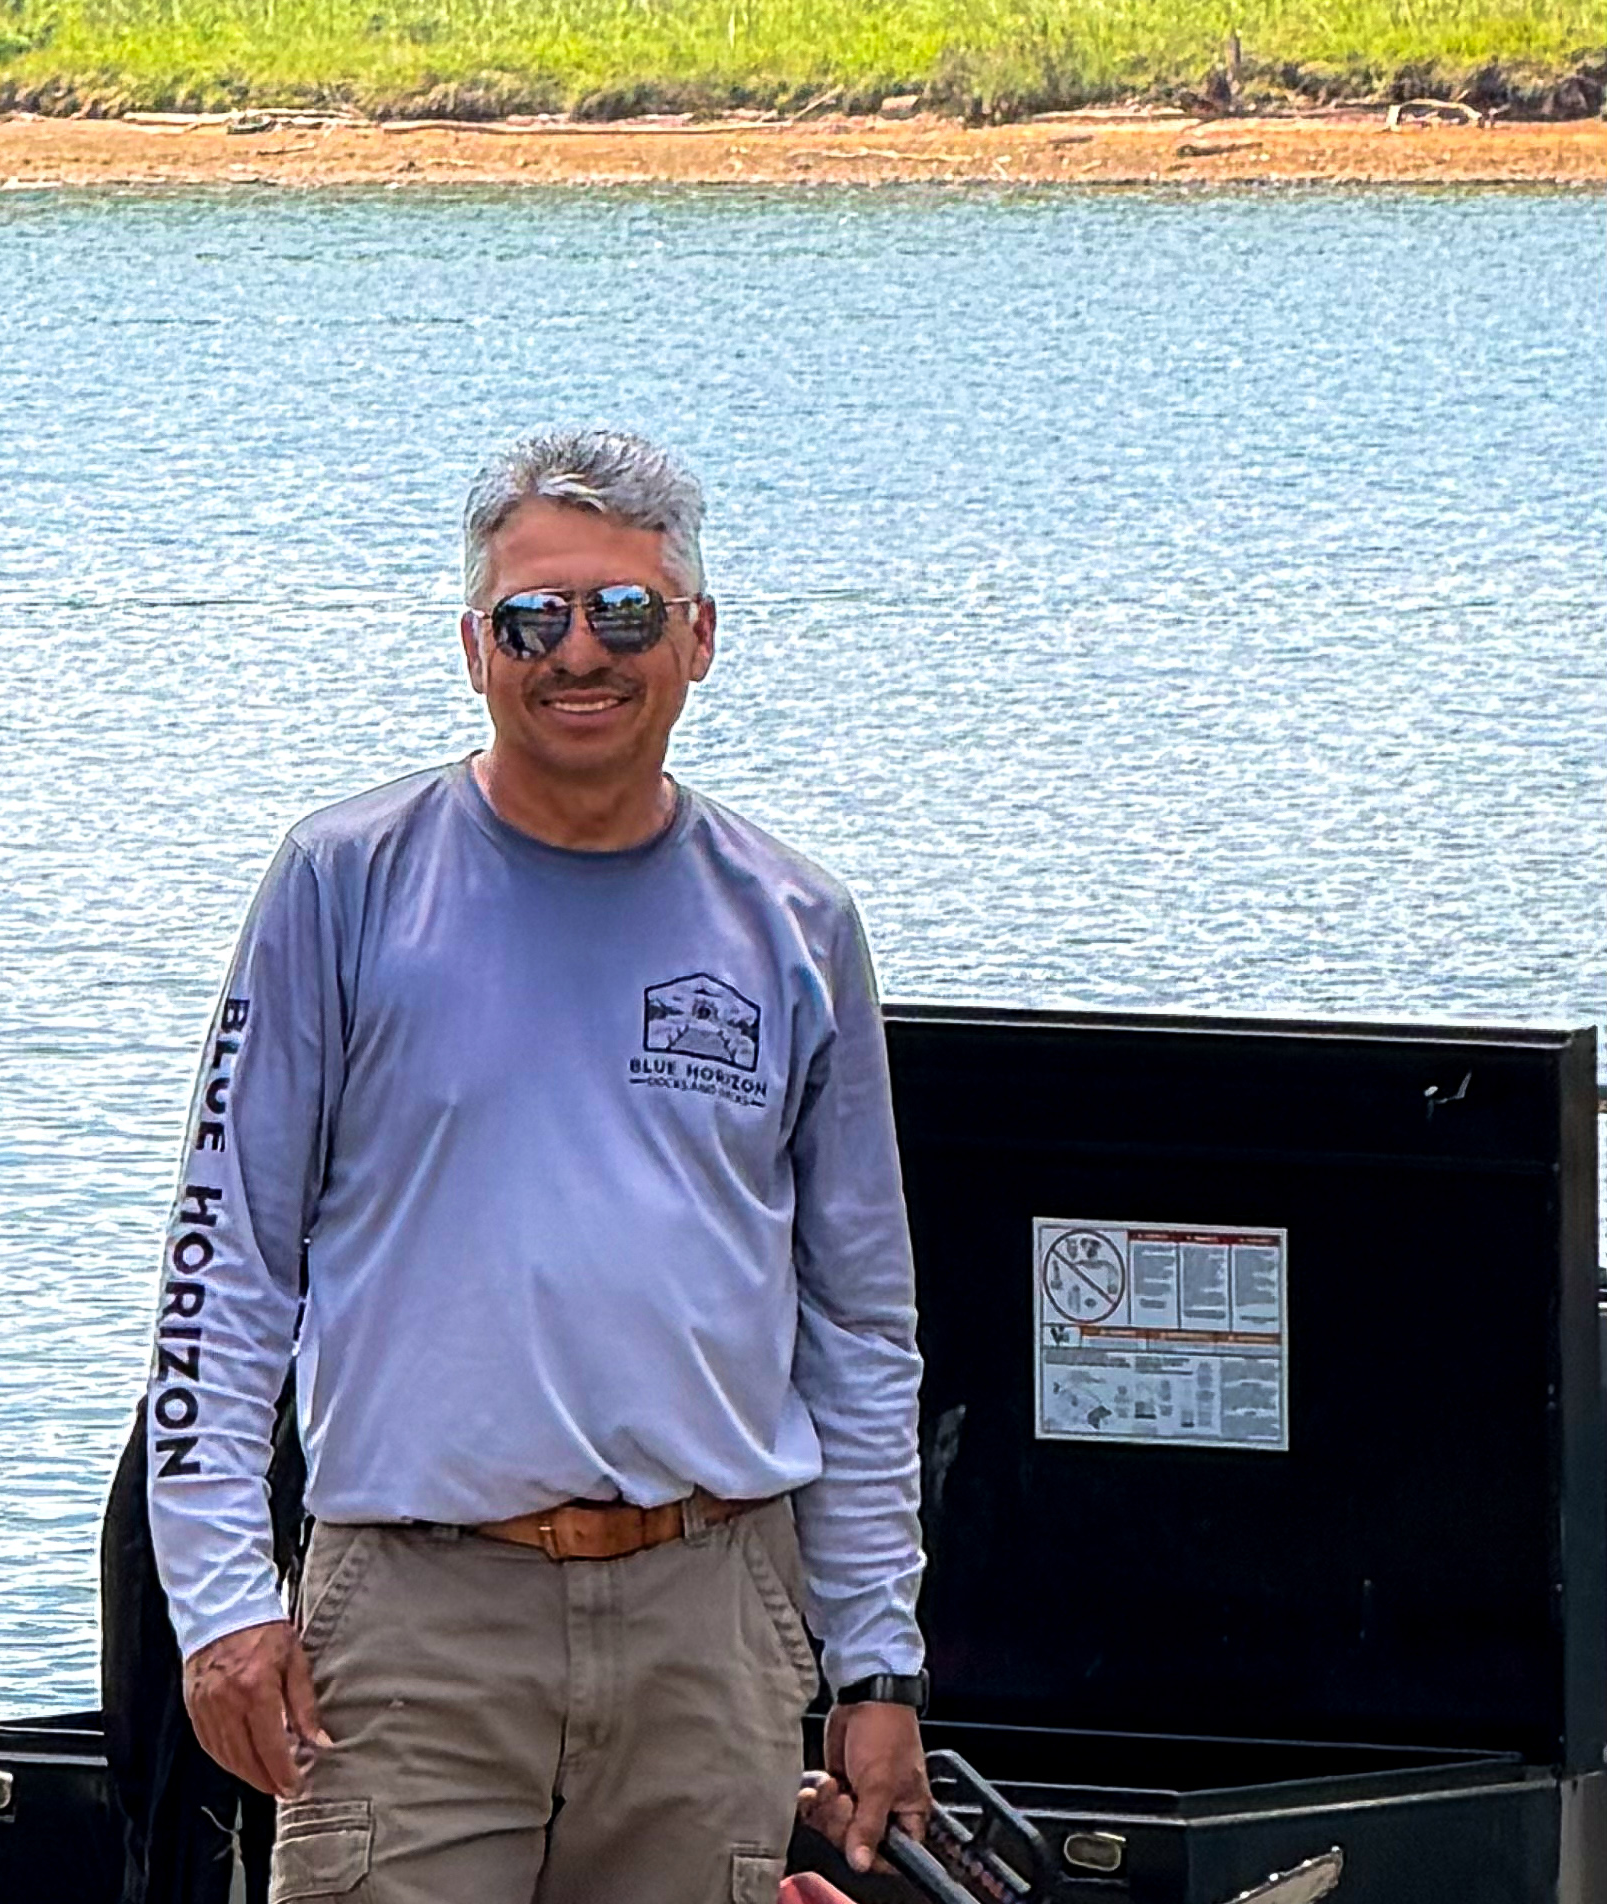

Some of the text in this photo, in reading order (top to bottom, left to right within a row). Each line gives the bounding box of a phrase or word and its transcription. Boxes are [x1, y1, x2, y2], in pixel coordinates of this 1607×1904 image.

[628, 1057, 768, 1098] BLUE HORIZON
[154, 997, 251, 1480] BLUE HORIZON
